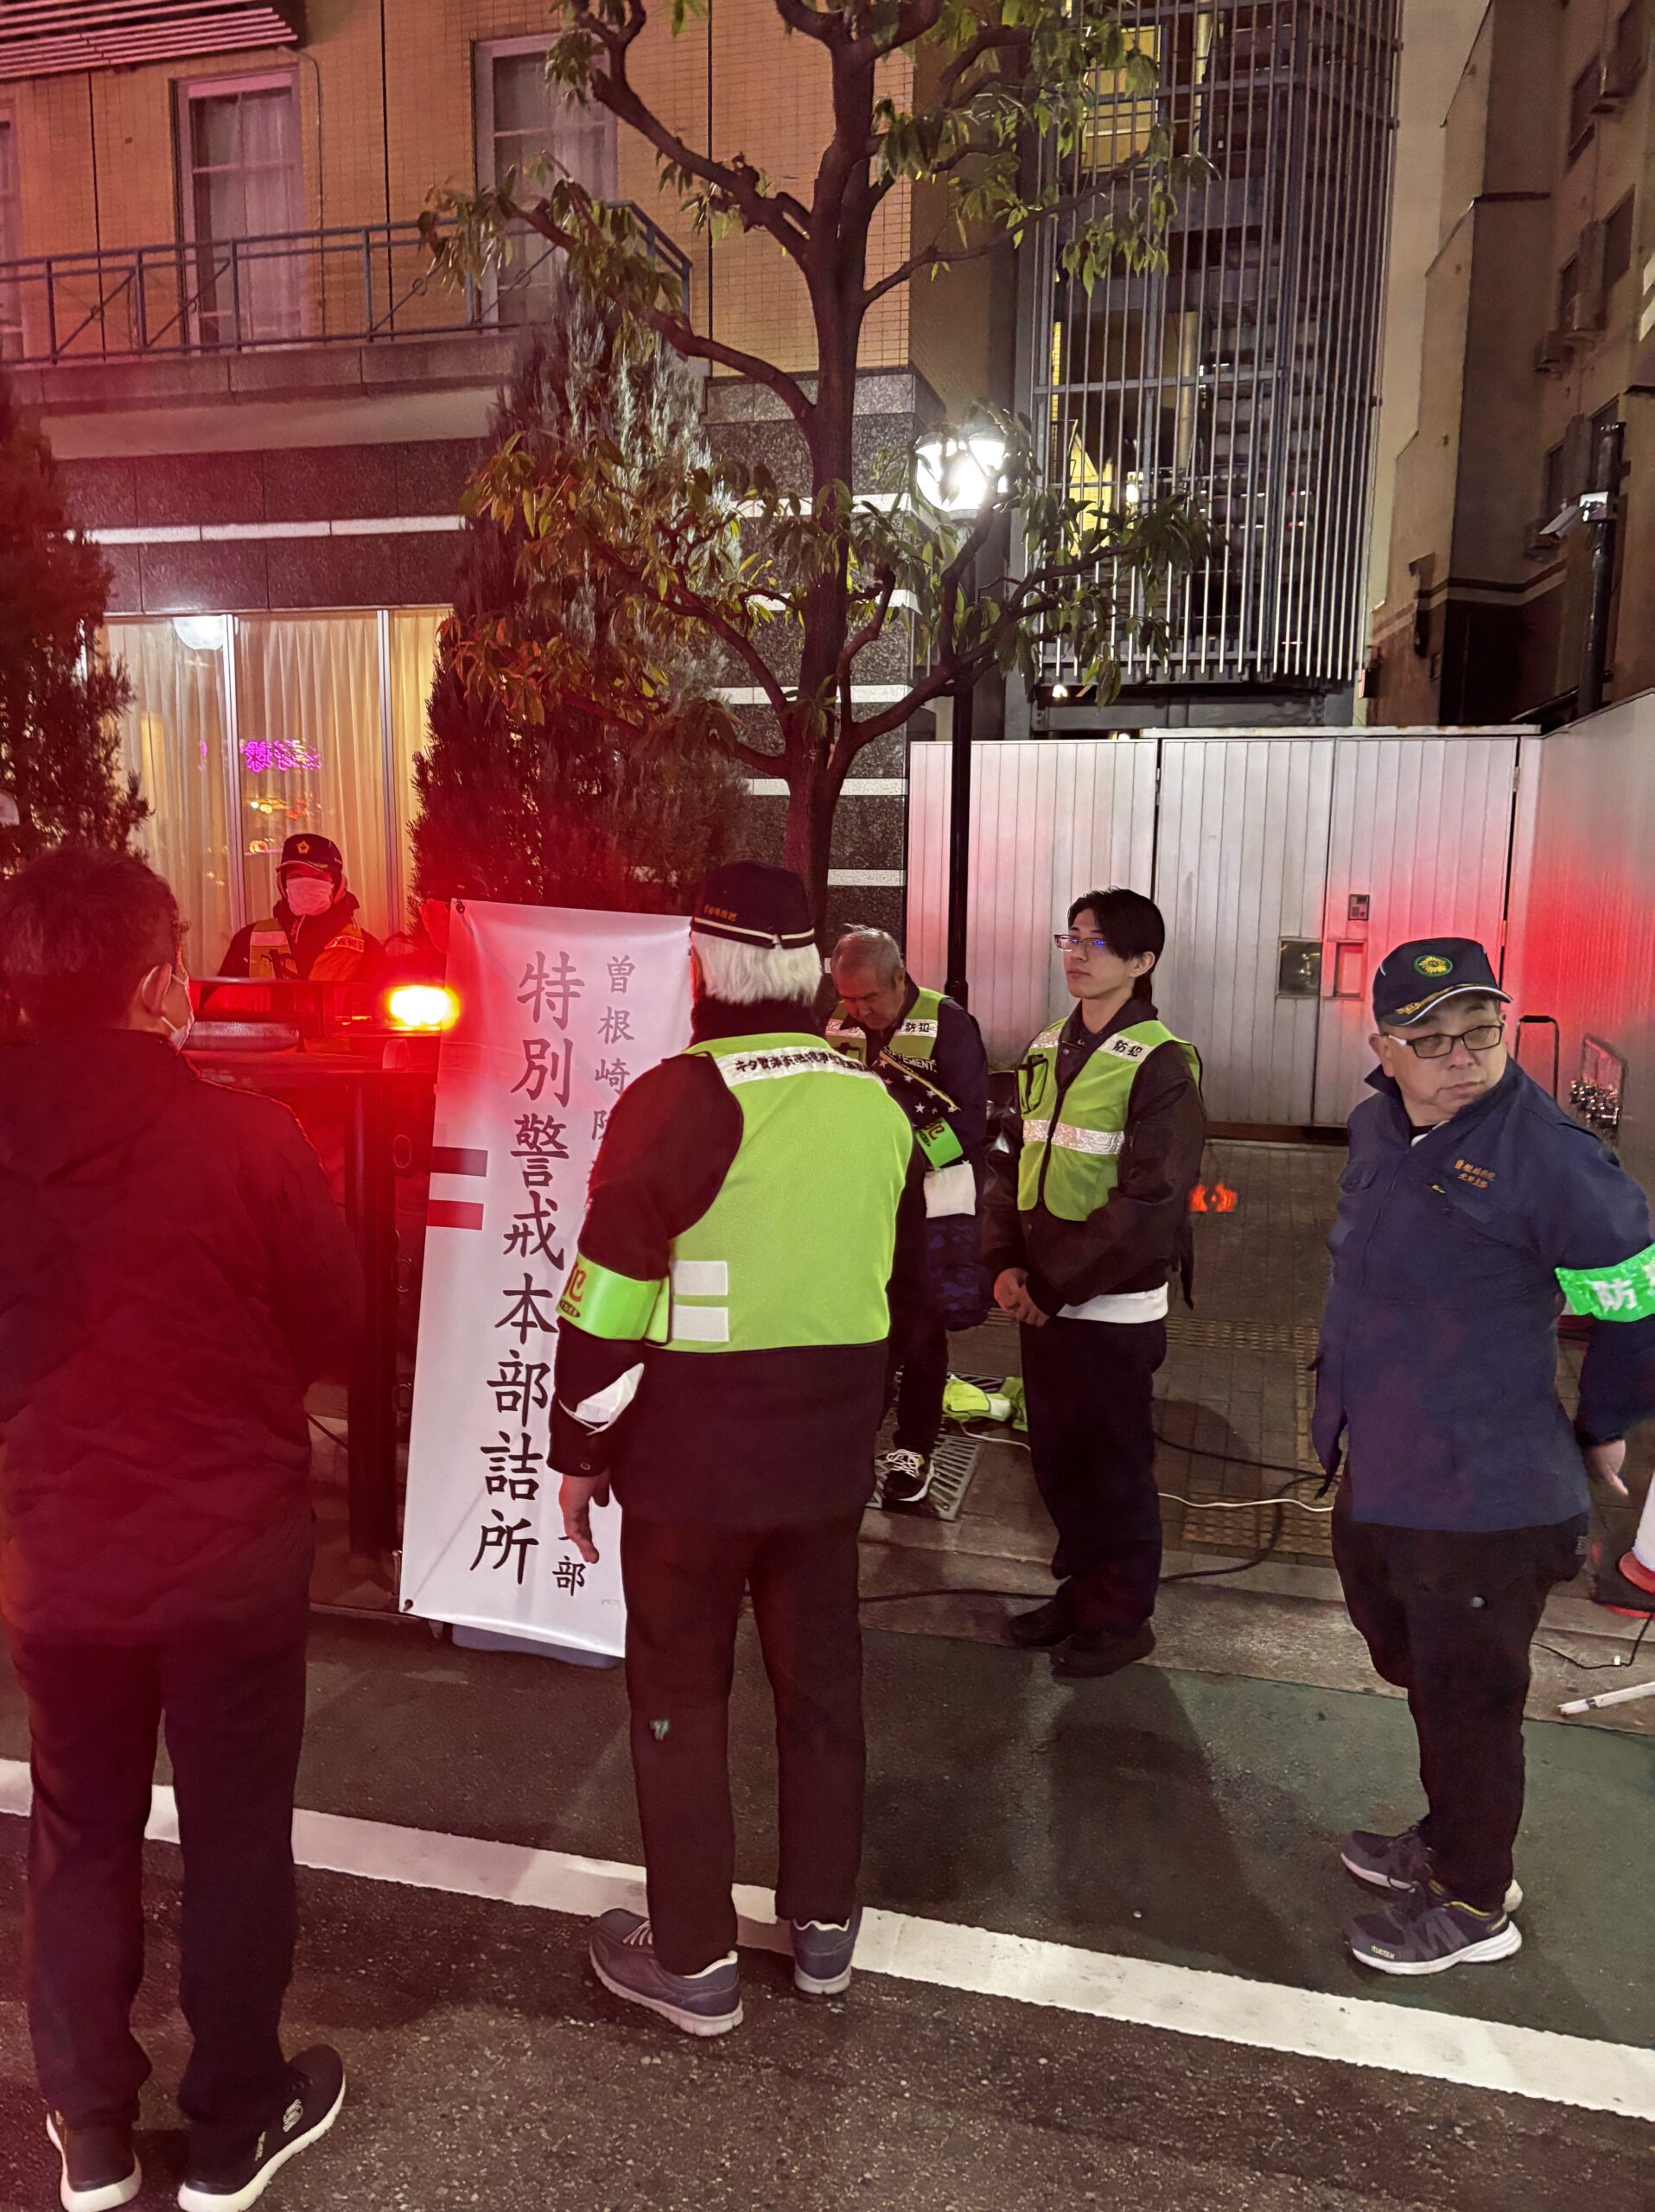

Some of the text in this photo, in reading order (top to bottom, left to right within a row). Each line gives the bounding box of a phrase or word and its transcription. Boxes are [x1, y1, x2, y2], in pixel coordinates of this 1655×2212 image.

[905, 1022, 930, 1033] 防犯
[1112, 1039, 1143, 1057] 防犯
[469, 950, 585, 1586] 特別警戒本部詰所
